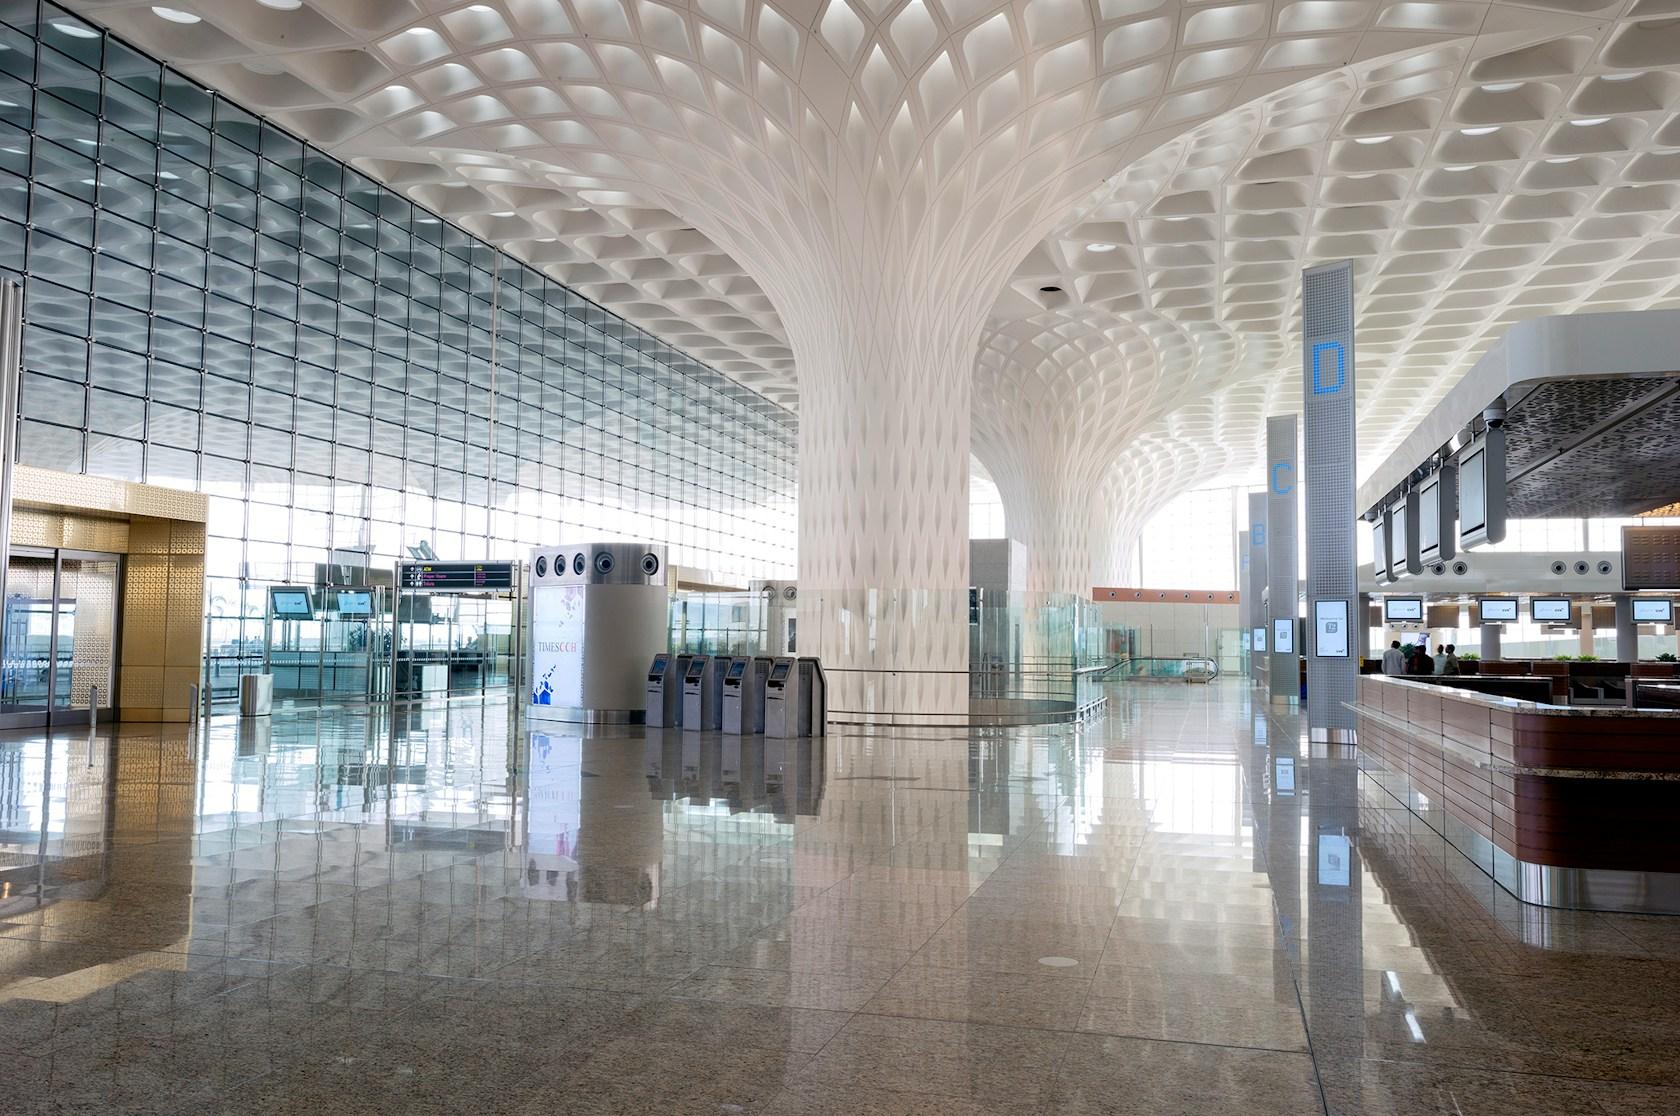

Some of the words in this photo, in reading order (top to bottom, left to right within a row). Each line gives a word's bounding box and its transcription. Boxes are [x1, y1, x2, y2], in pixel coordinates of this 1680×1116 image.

[1313, 342, 1345, 394] D
[1271, 463, 1296, 495] C
[1252, 523, 1265, 545] B
